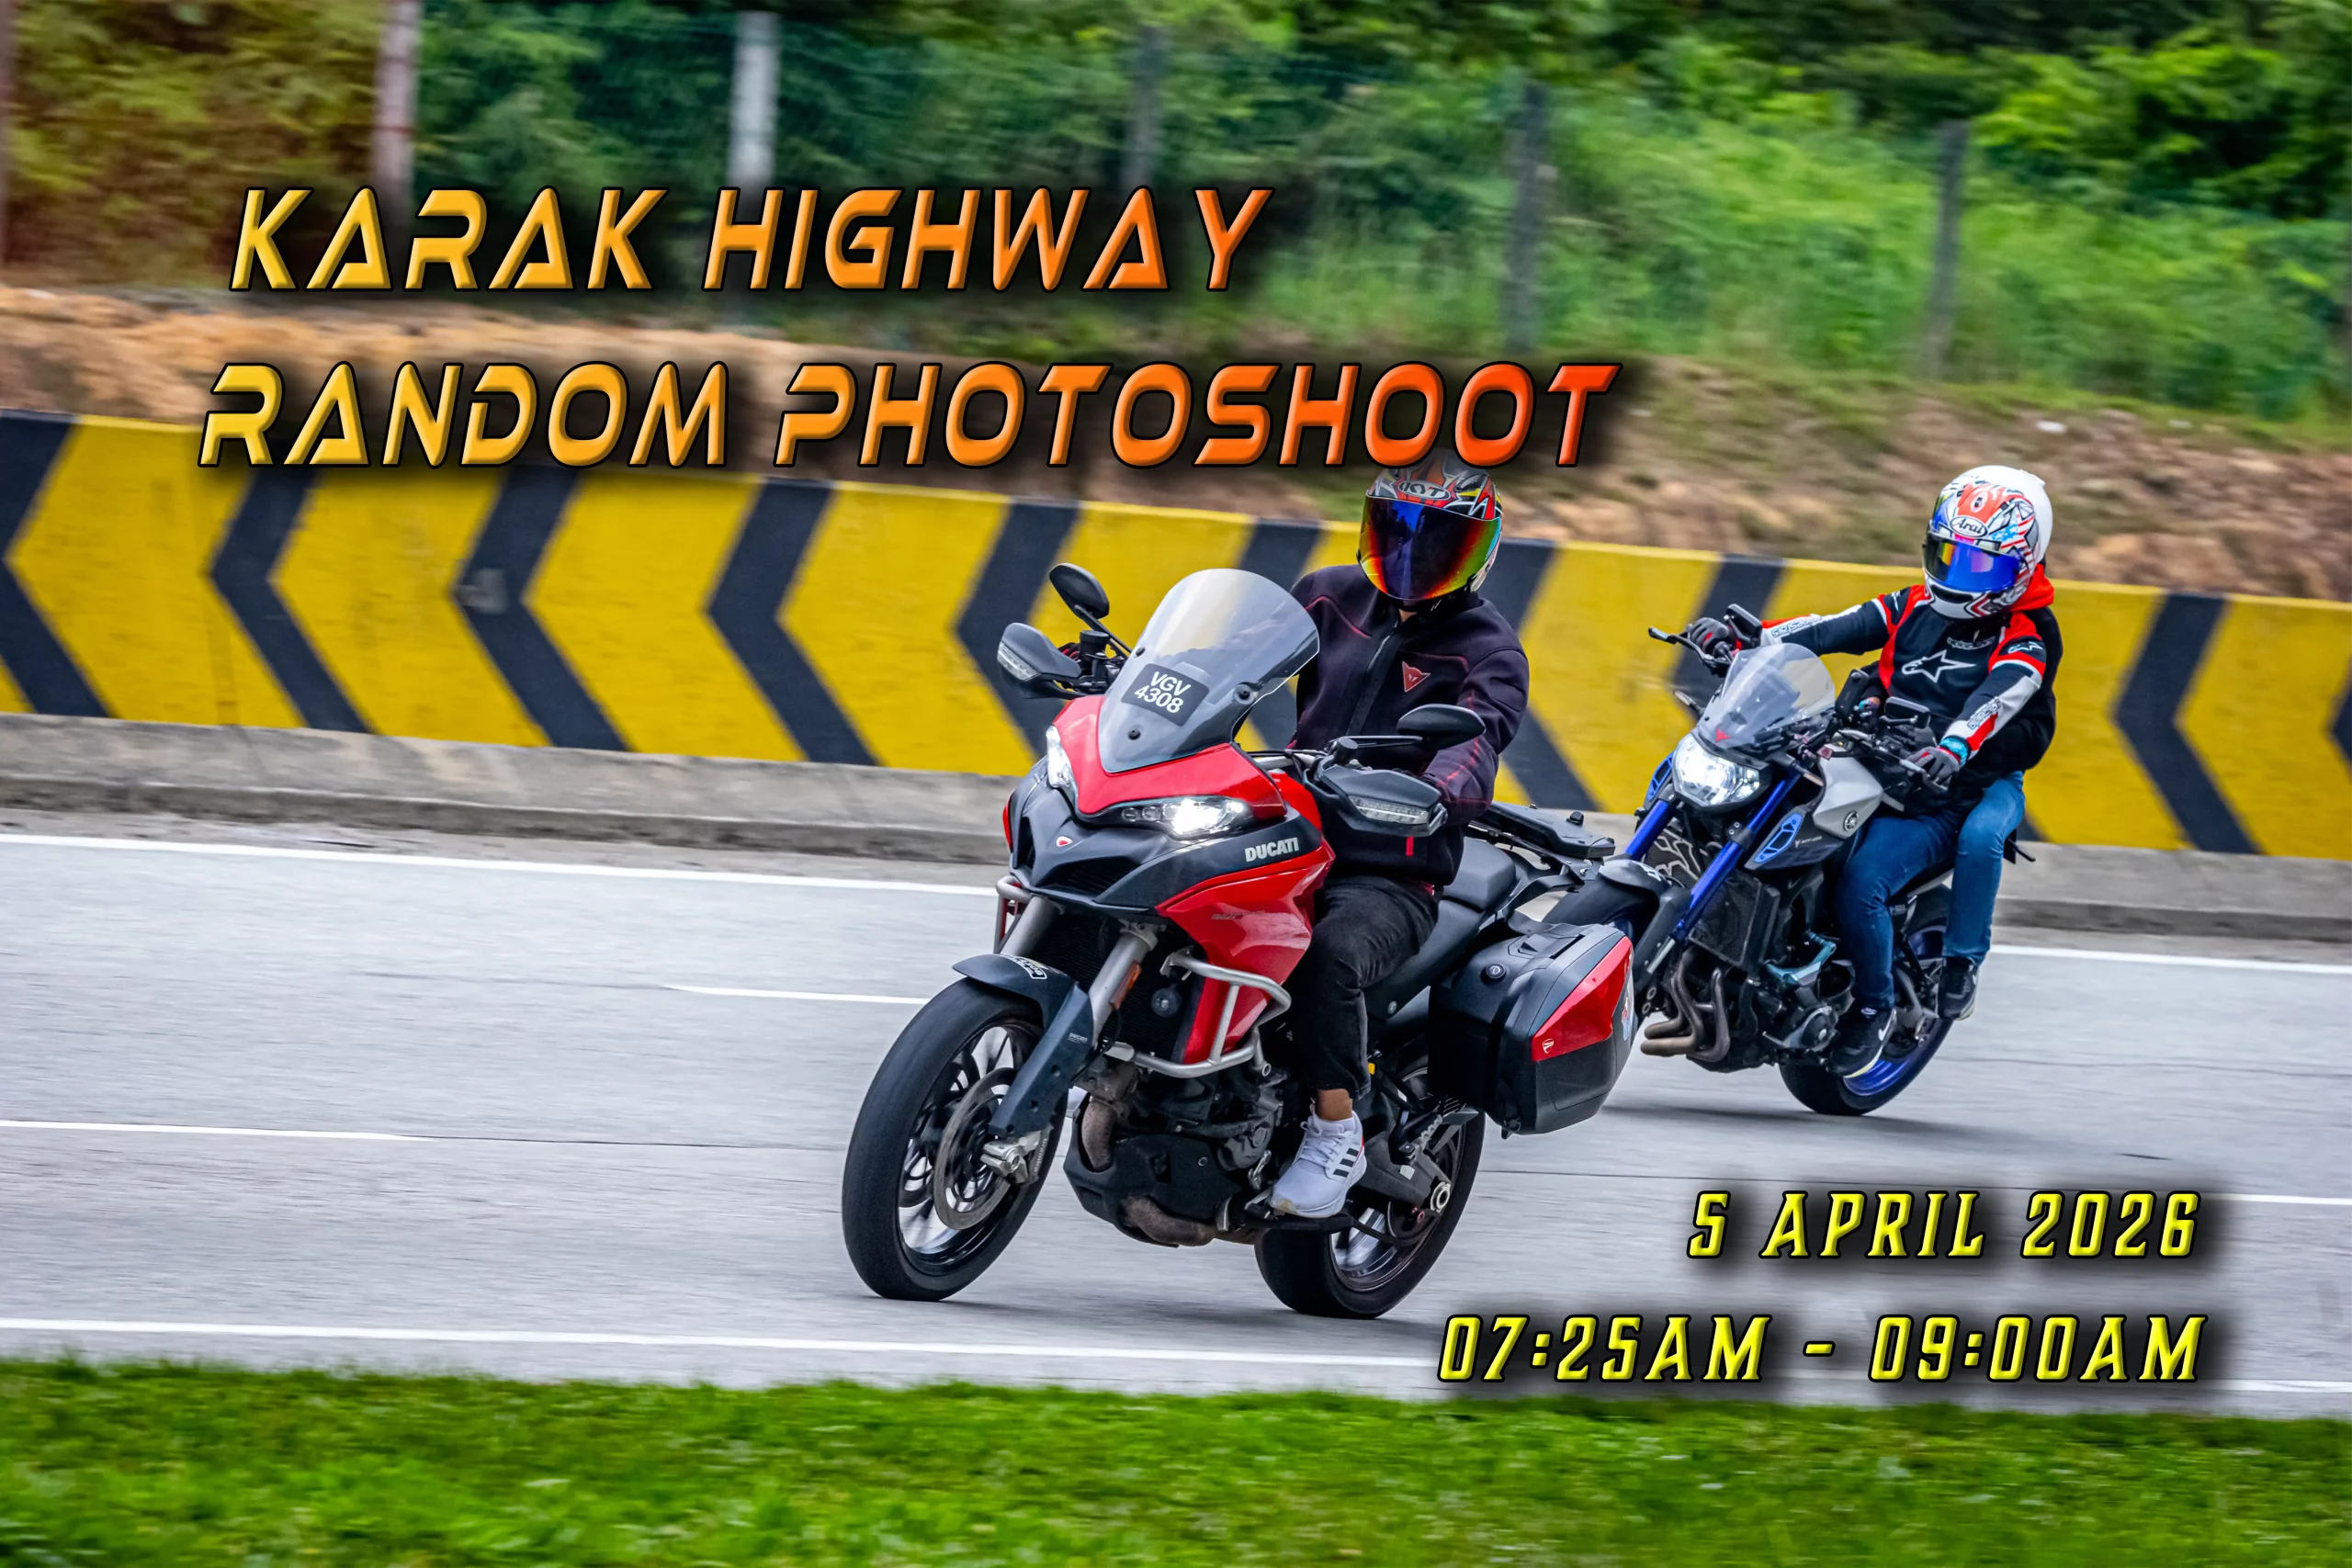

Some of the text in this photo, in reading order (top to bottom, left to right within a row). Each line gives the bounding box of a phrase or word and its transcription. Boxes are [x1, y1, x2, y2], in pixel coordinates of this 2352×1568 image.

[1951, 517, 1983, 535] Arai
[1150, 671, 1192, 696] VGV
[1134, 684, 1183, 714] 4308
[1244, 836, 1300, 863] DUCATI
